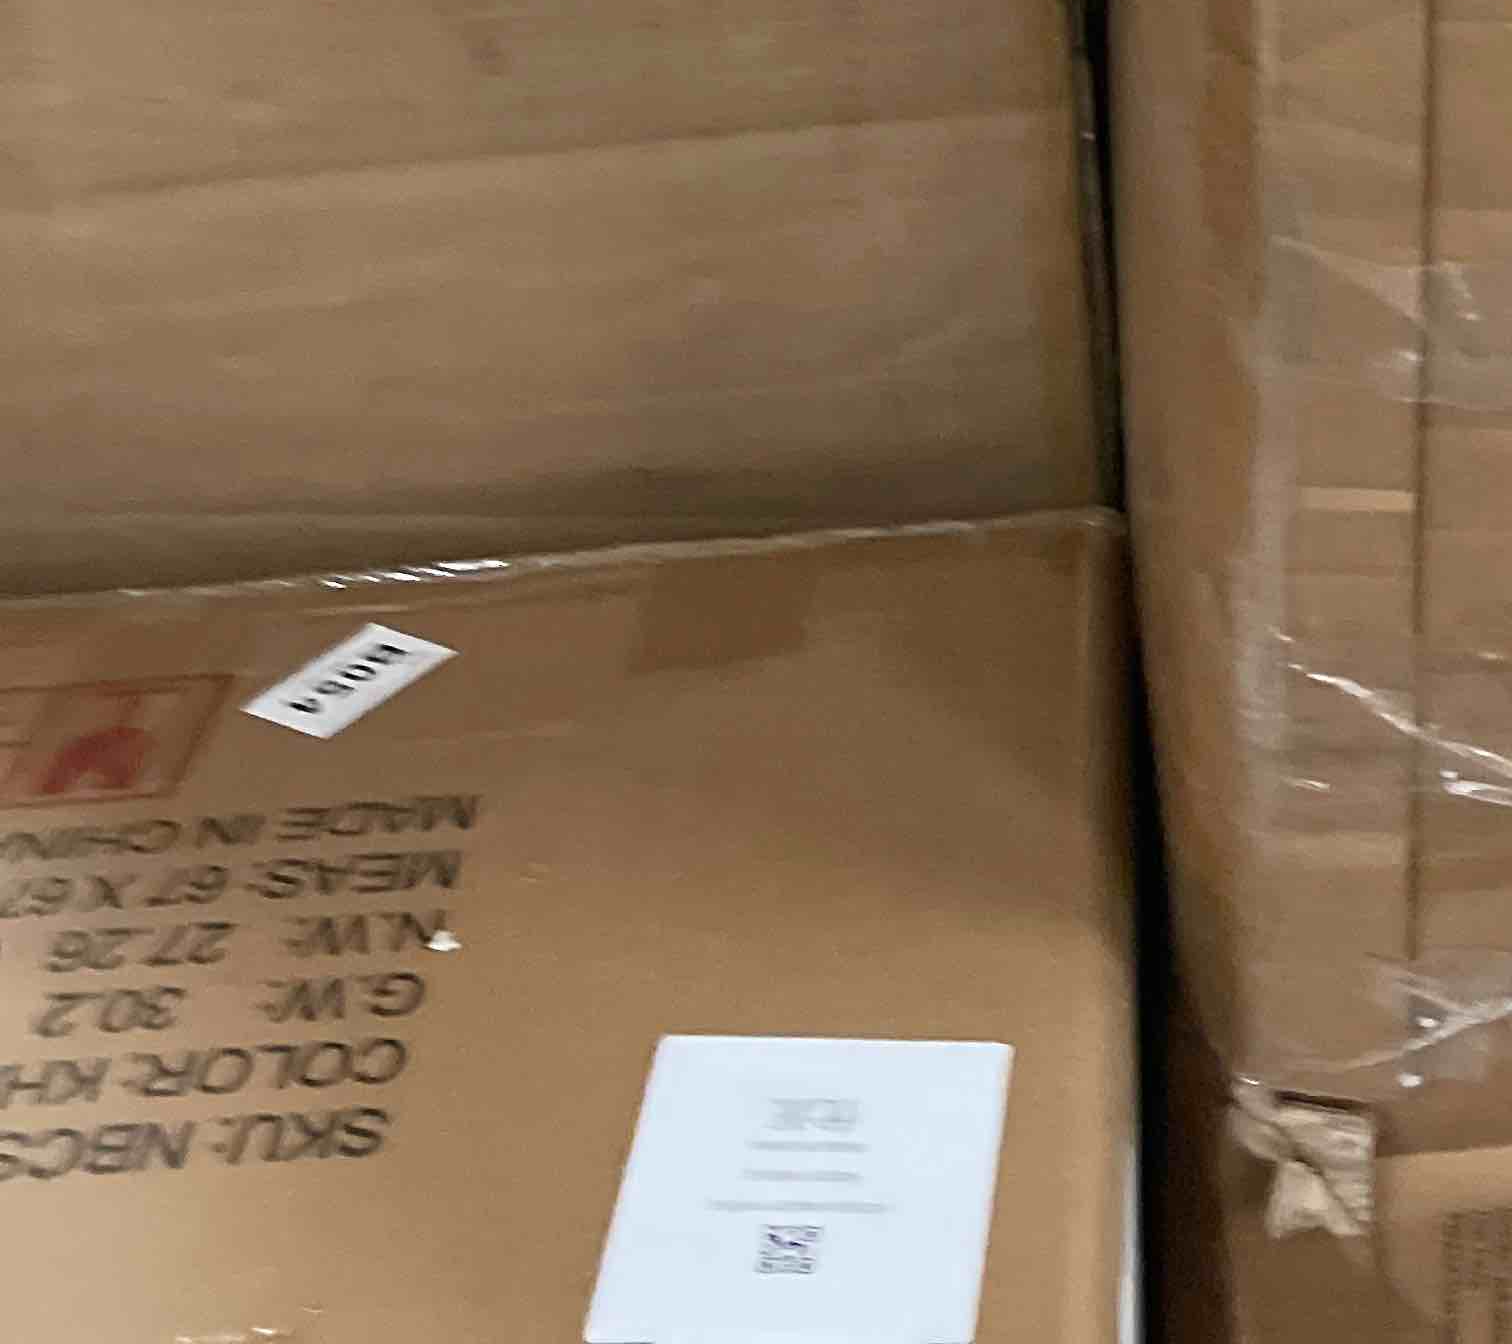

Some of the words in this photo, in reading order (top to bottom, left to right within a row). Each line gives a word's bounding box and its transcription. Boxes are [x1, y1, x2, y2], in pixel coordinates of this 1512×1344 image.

[0, 818, 183, 862] CHIN
[199, 813, 267, 846] IN
[274, 793, 484, 840] MADE
[144, 864, 230, 907] 67
[244, 848, 464, 900] MEAS:
[44, 920, 239, 973] 27.26
[31, 985, 188, 1039] 30.2
[121, 1037, 408, 1098] COLOR:
[210, 1107, 392, 1165] SKU:
